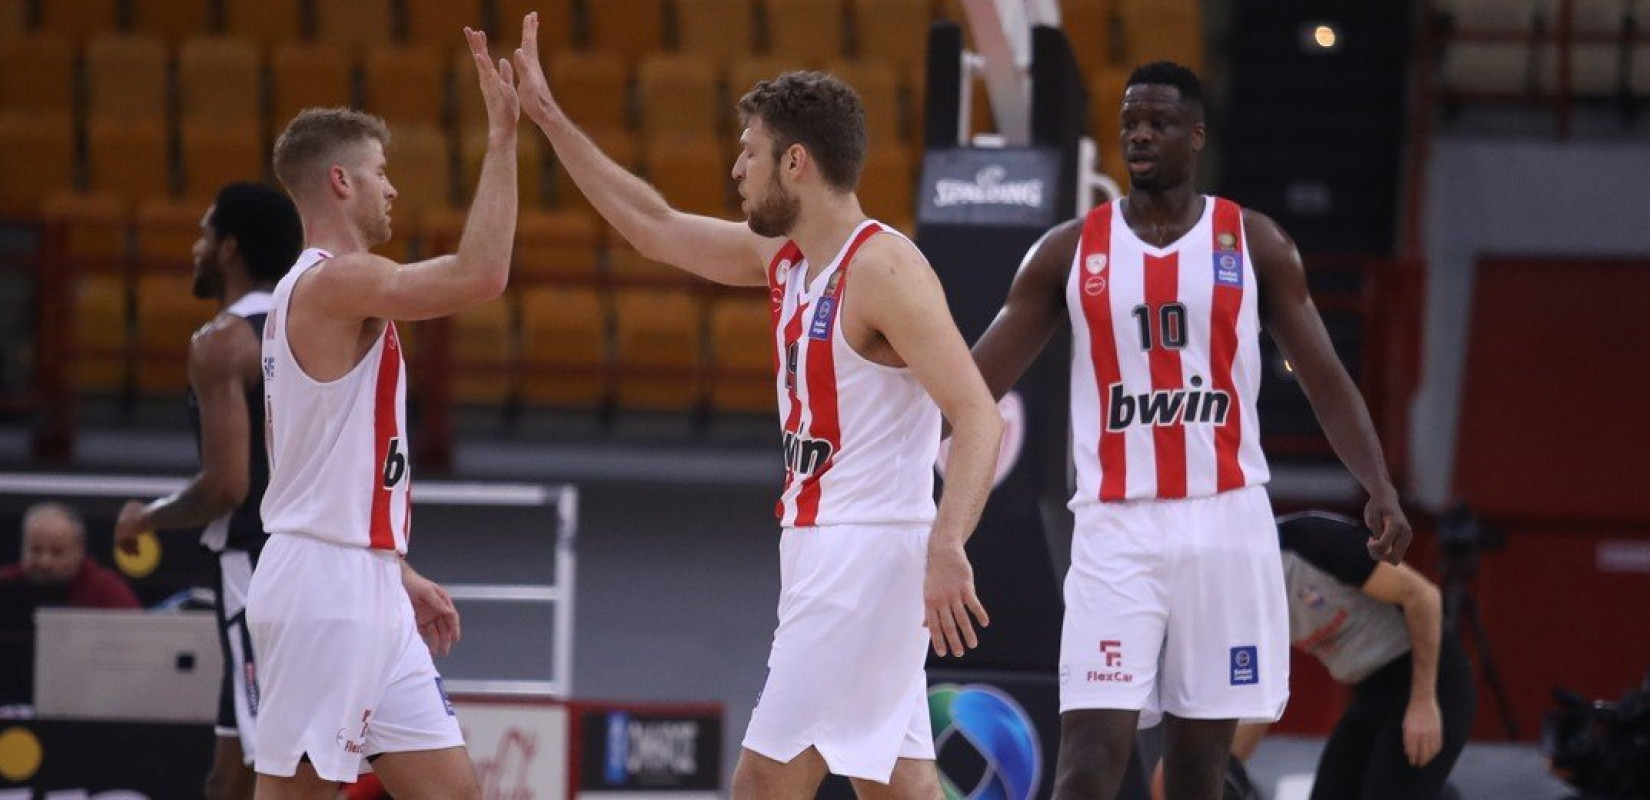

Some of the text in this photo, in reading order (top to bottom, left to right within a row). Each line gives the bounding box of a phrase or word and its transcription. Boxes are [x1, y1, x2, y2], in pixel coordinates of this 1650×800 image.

[1131, 302, 1189, 351] 10
[1106, 375, 1230, 433] bwin
[1087, 671, 1133, 682] FlexCar
